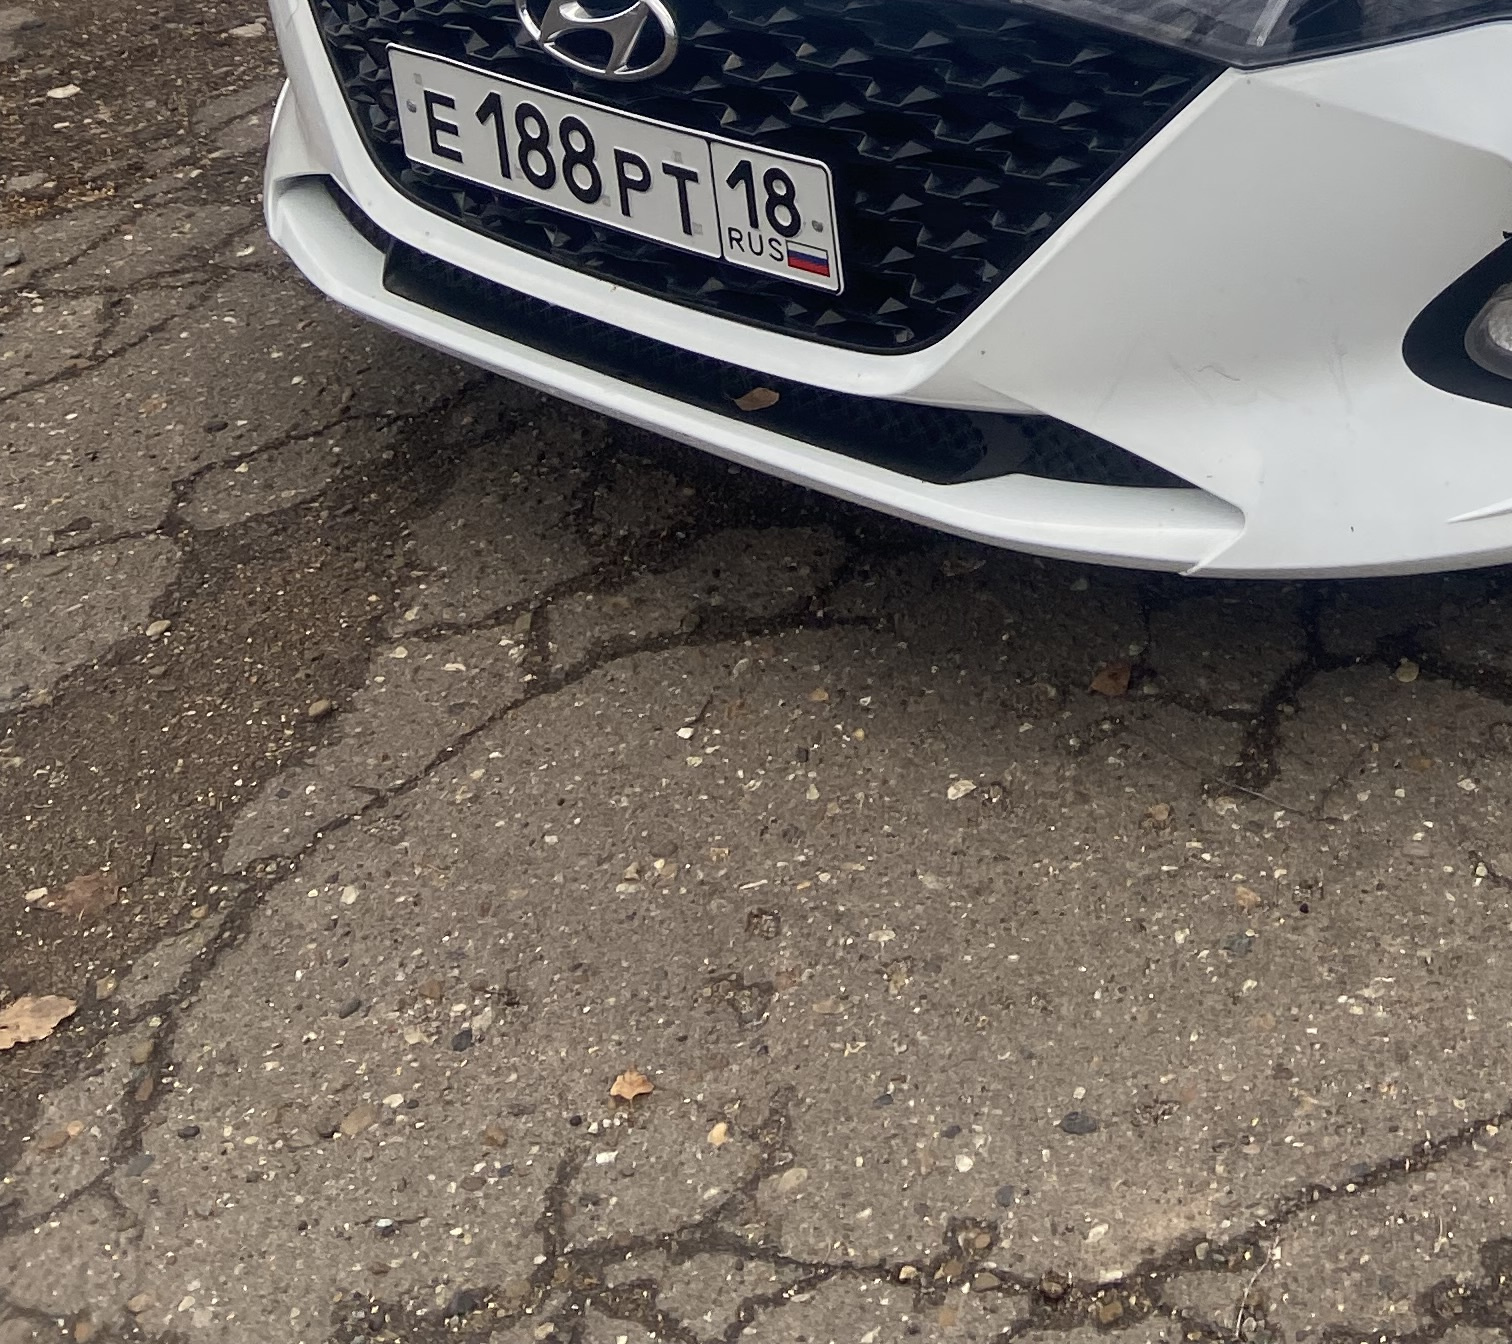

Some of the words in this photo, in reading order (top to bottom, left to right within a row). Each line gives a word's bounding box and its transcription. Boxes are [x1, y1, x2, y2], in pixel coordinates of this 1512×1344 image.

[423, 89, 699, 236] E188PT
[725, 159, 801, 238] 18
[728, 227, 784, 262] RUS
